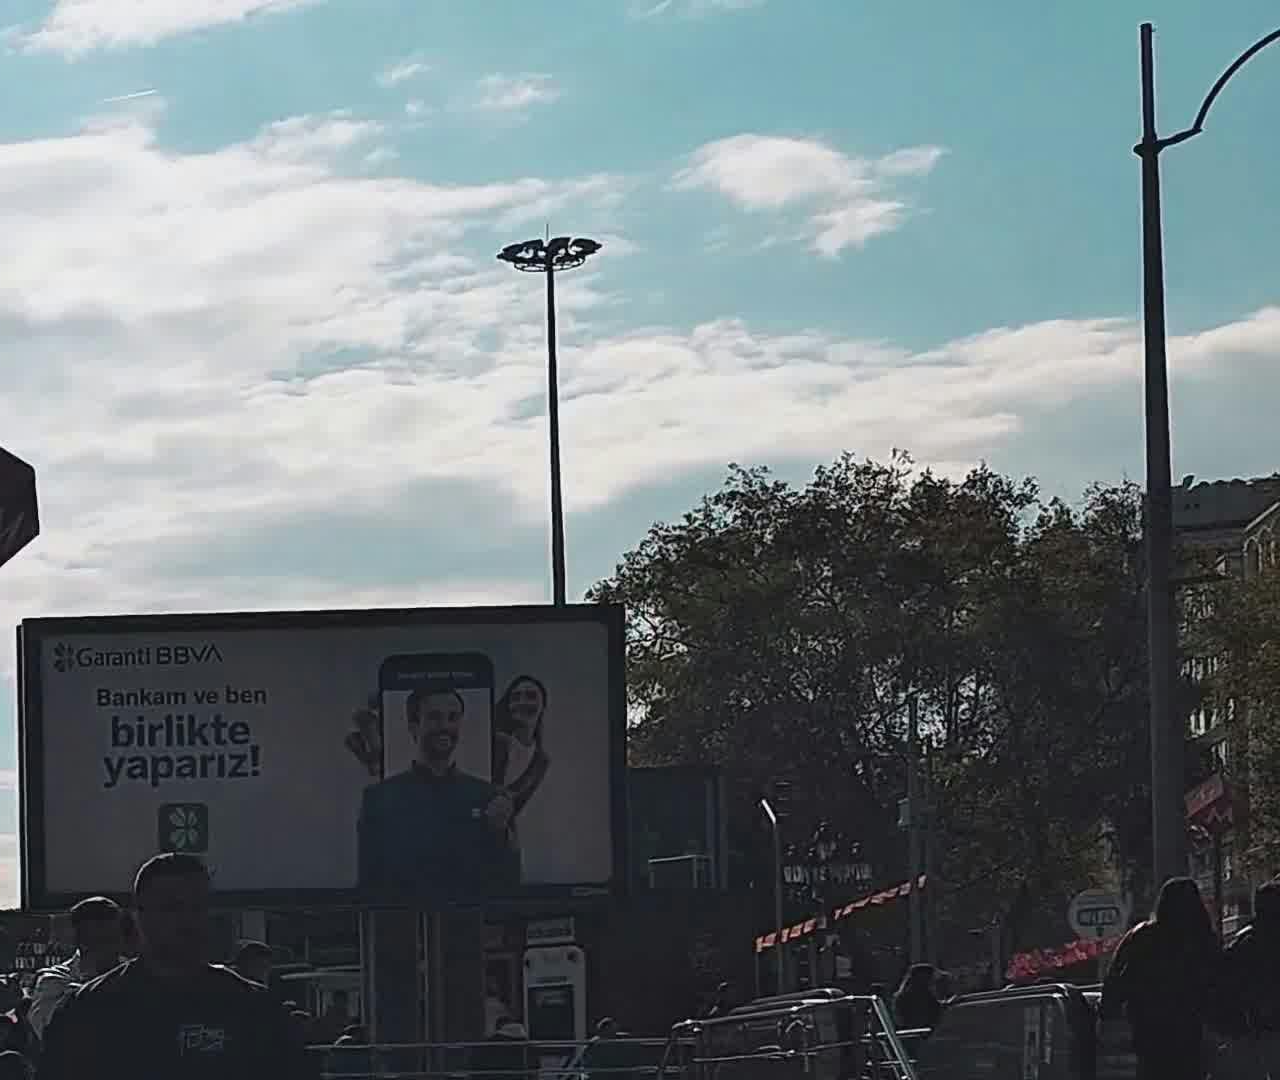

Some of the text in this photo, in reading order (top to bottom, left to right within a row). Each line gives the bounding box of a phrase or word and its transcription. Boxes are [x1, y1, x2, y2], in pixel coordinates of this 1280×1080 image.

[76, 644, 223, 667] Garanti BBVA
[96, 685, 267, 707] Bankam ve ben
[111, 713, 250, 747] birlikte
[103, 744, 261, 788] yaparız!
